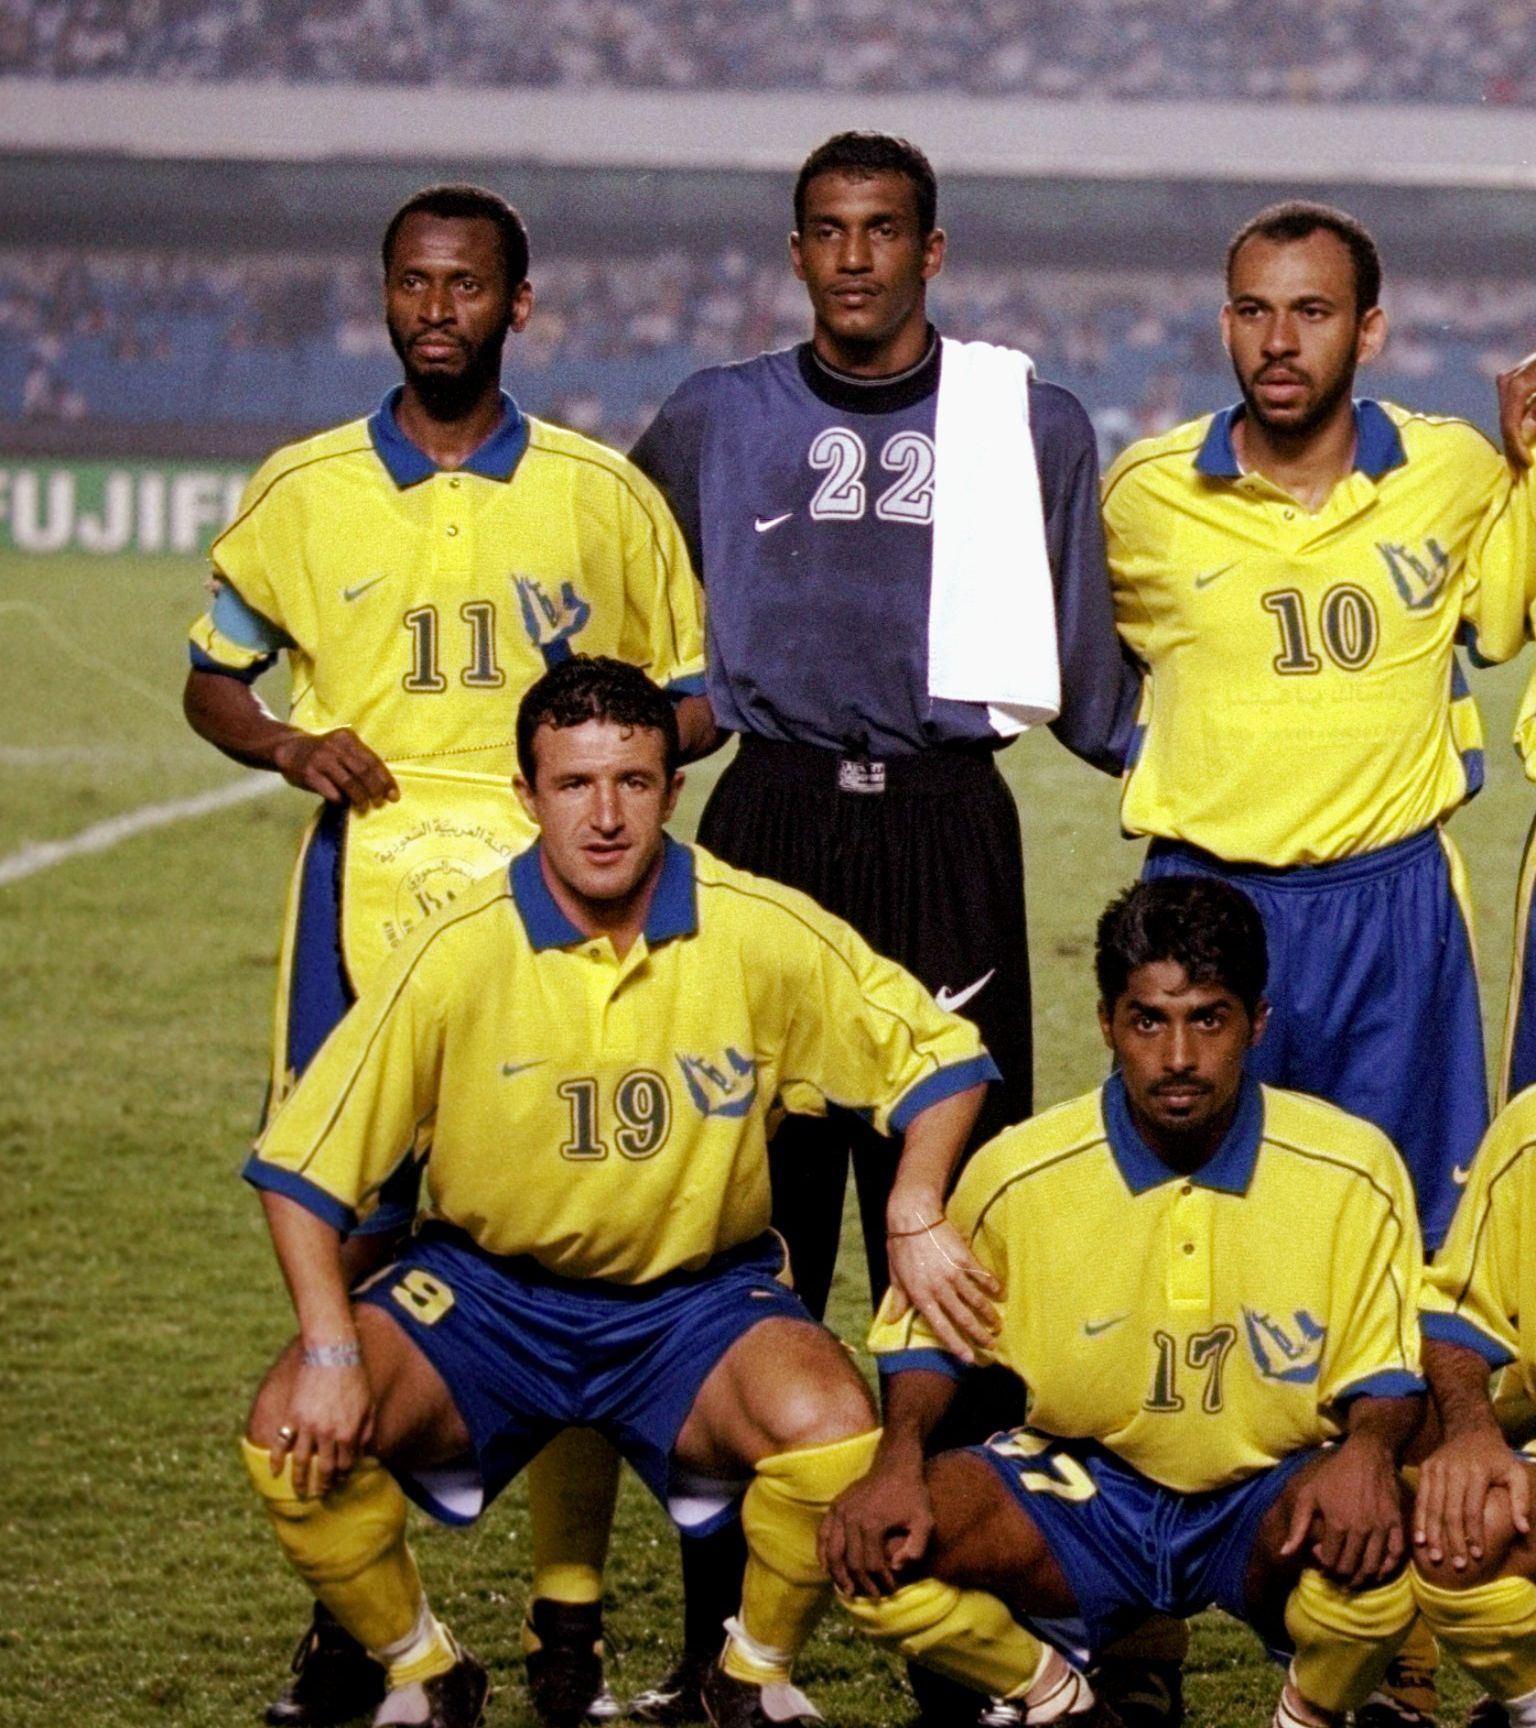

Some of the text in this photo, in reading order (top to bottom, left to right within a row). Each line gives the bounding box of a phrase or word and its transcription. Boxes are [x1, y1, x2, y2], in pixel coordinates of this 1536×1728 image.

[0, 470, 244, 552] UJIF
[810, 428, 934, 523] 22
[403, 601, 504, 692] 11
[1262, 583, 1380, 676] 10
[558, 1069, 671, 1161] 19
[1141, 1324, 1236, 1414] 17
